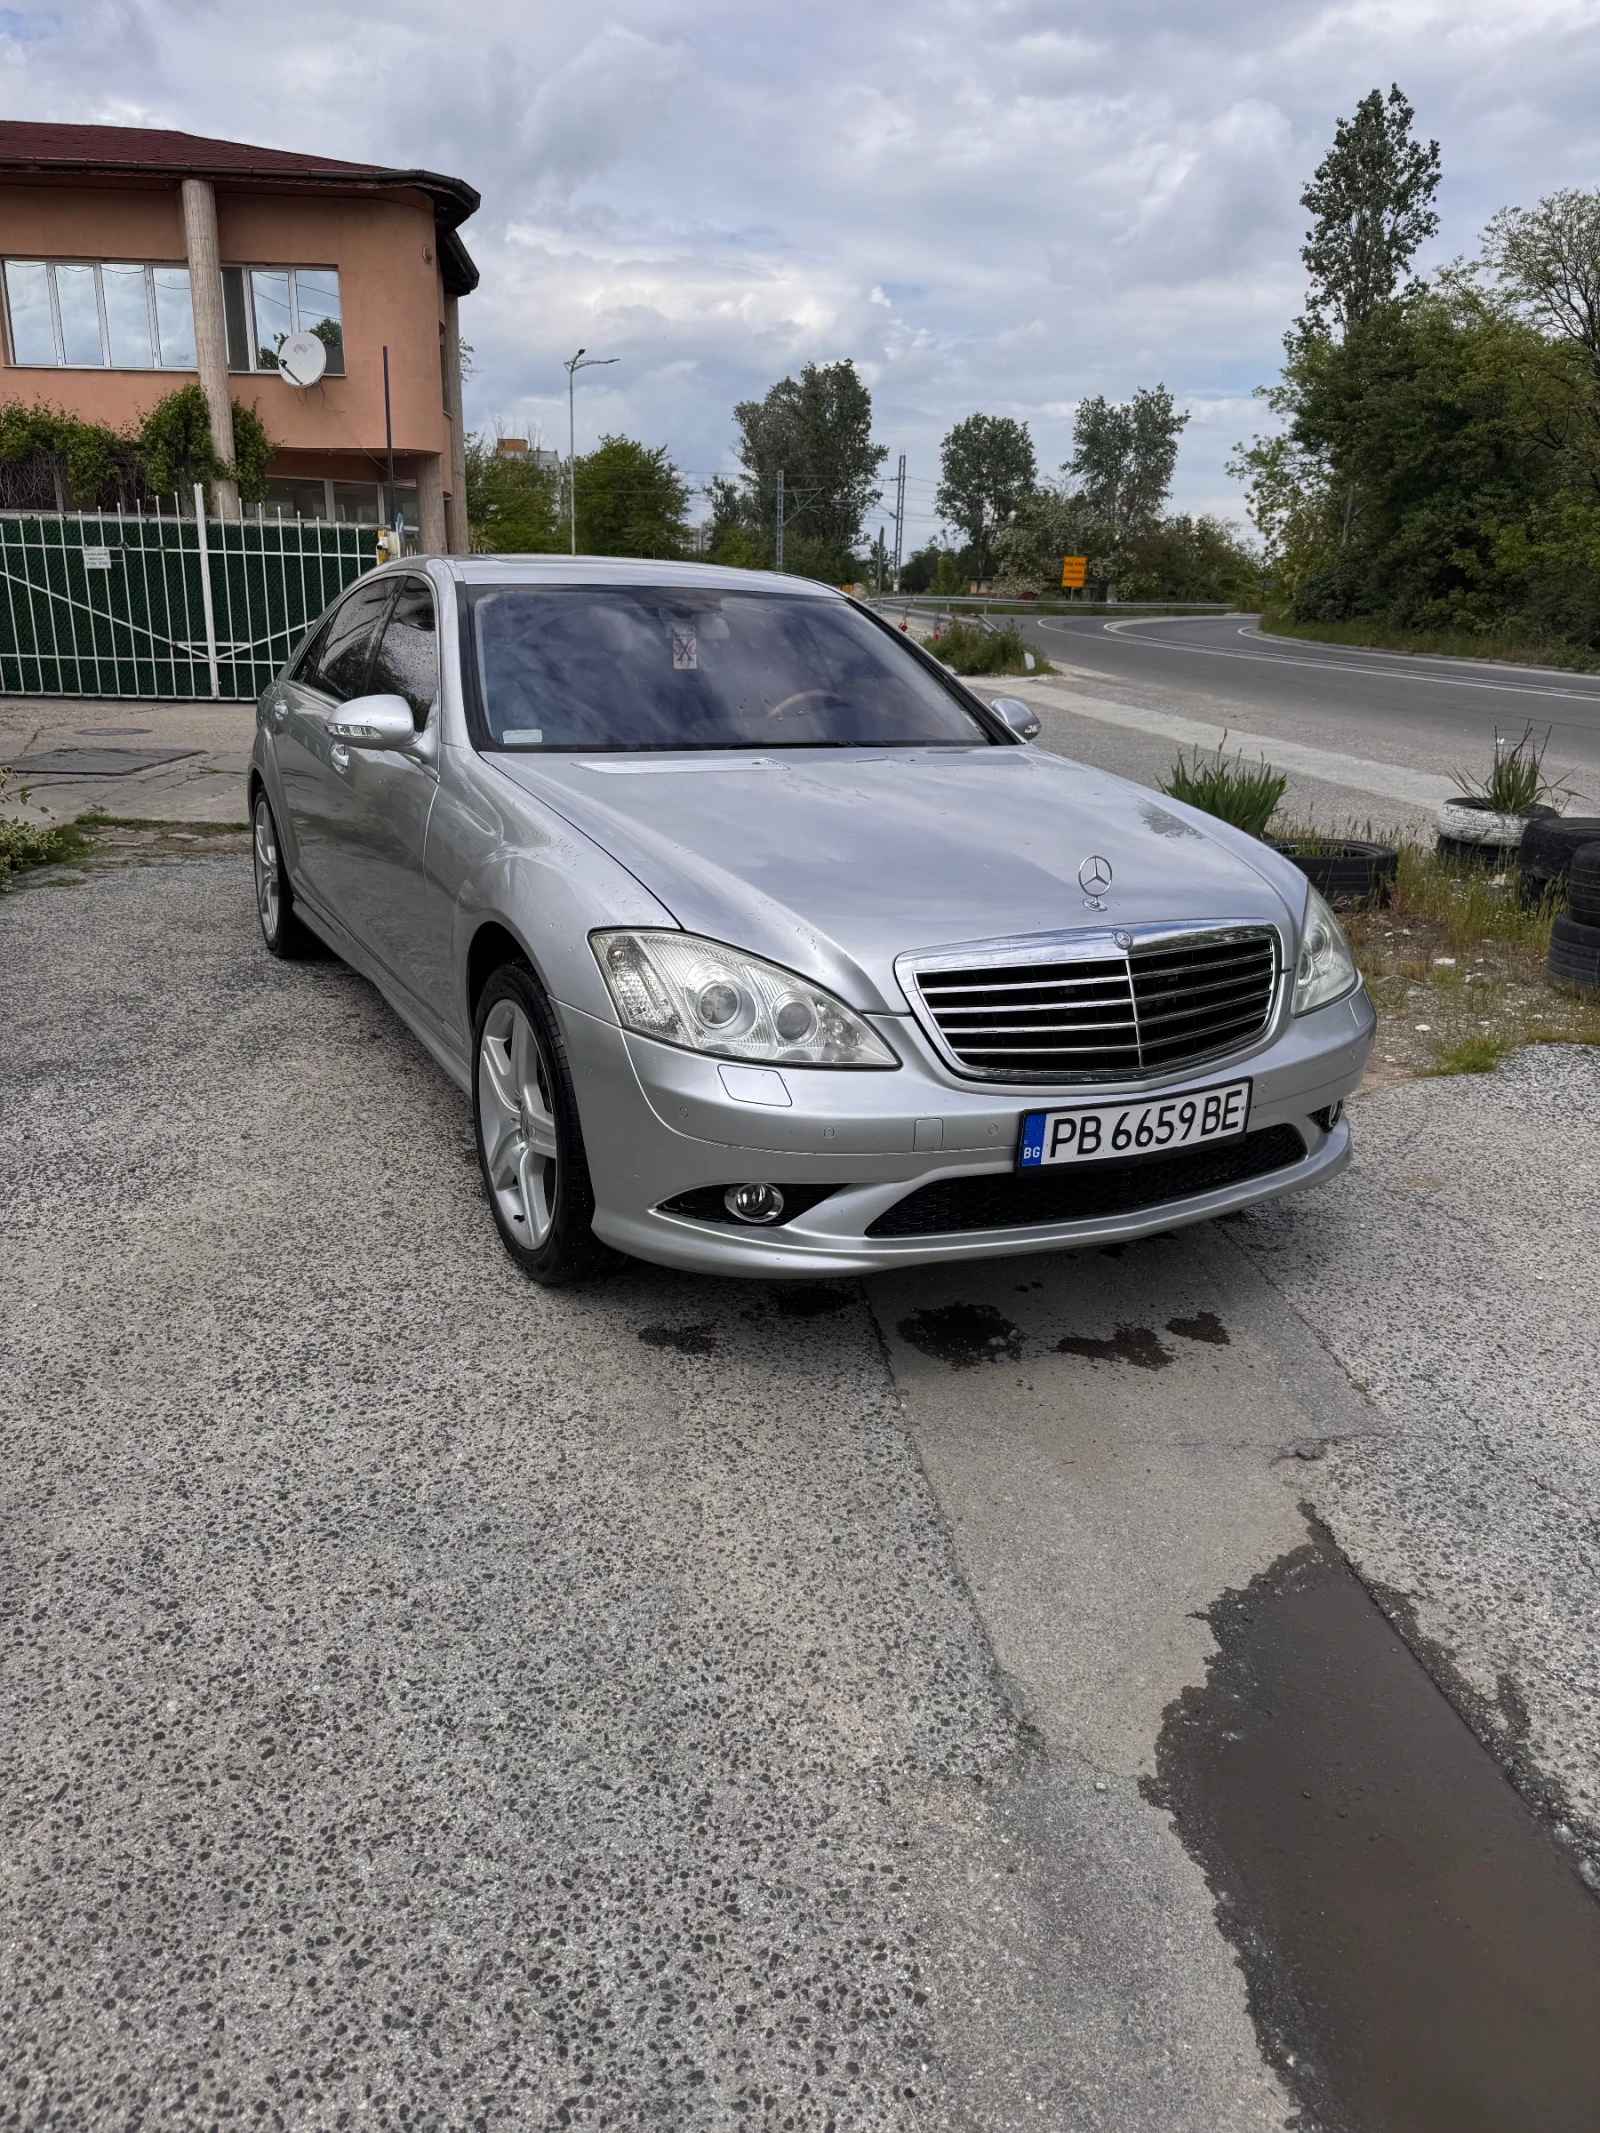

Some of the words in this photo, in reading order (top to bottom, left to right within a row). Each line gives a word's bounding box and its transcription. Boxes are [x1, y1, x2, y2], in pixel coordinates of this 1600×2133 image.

[1049, 1116, 1102, 1158] PB
[1111, 1101, 1197, 1151] 6659
[1200, 1089, 1242, 1136] BE
[1023, 1146, 1041, 1159] BG
